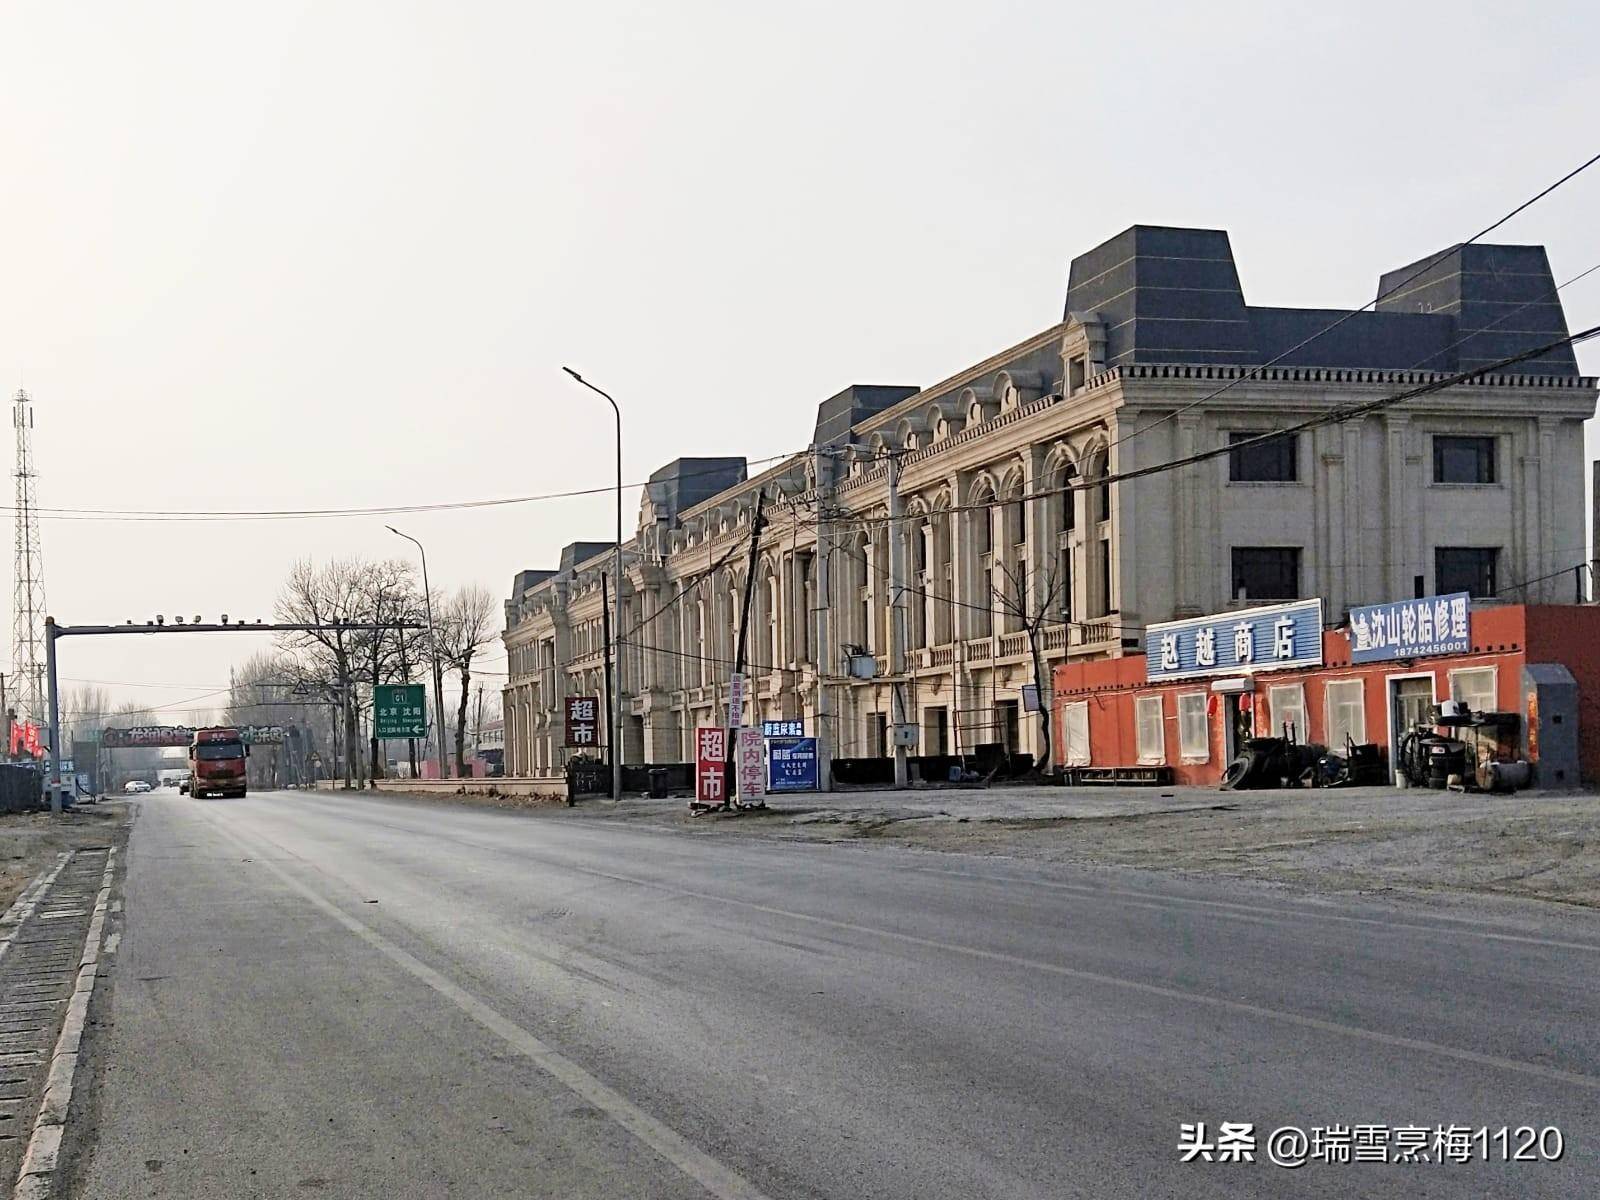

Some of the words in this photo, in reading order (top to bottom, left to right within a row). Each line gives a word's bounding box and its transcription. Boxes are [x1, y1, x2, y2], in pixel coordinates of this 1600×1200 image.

[1160, 615, 1298, 671] 赵越商店
[1371, 597, 1467, 647] 沈山轮胎修理
[1393, 641, 1468, 657] 18742456001
[380, 707, 397, 717] 北京
[402, 706, 421, 717] 沈阳
[570, 700, 594, 743] 超市
[701, 731, 724, 799] 超市
[742, 731, 763, 796] 院内停车
